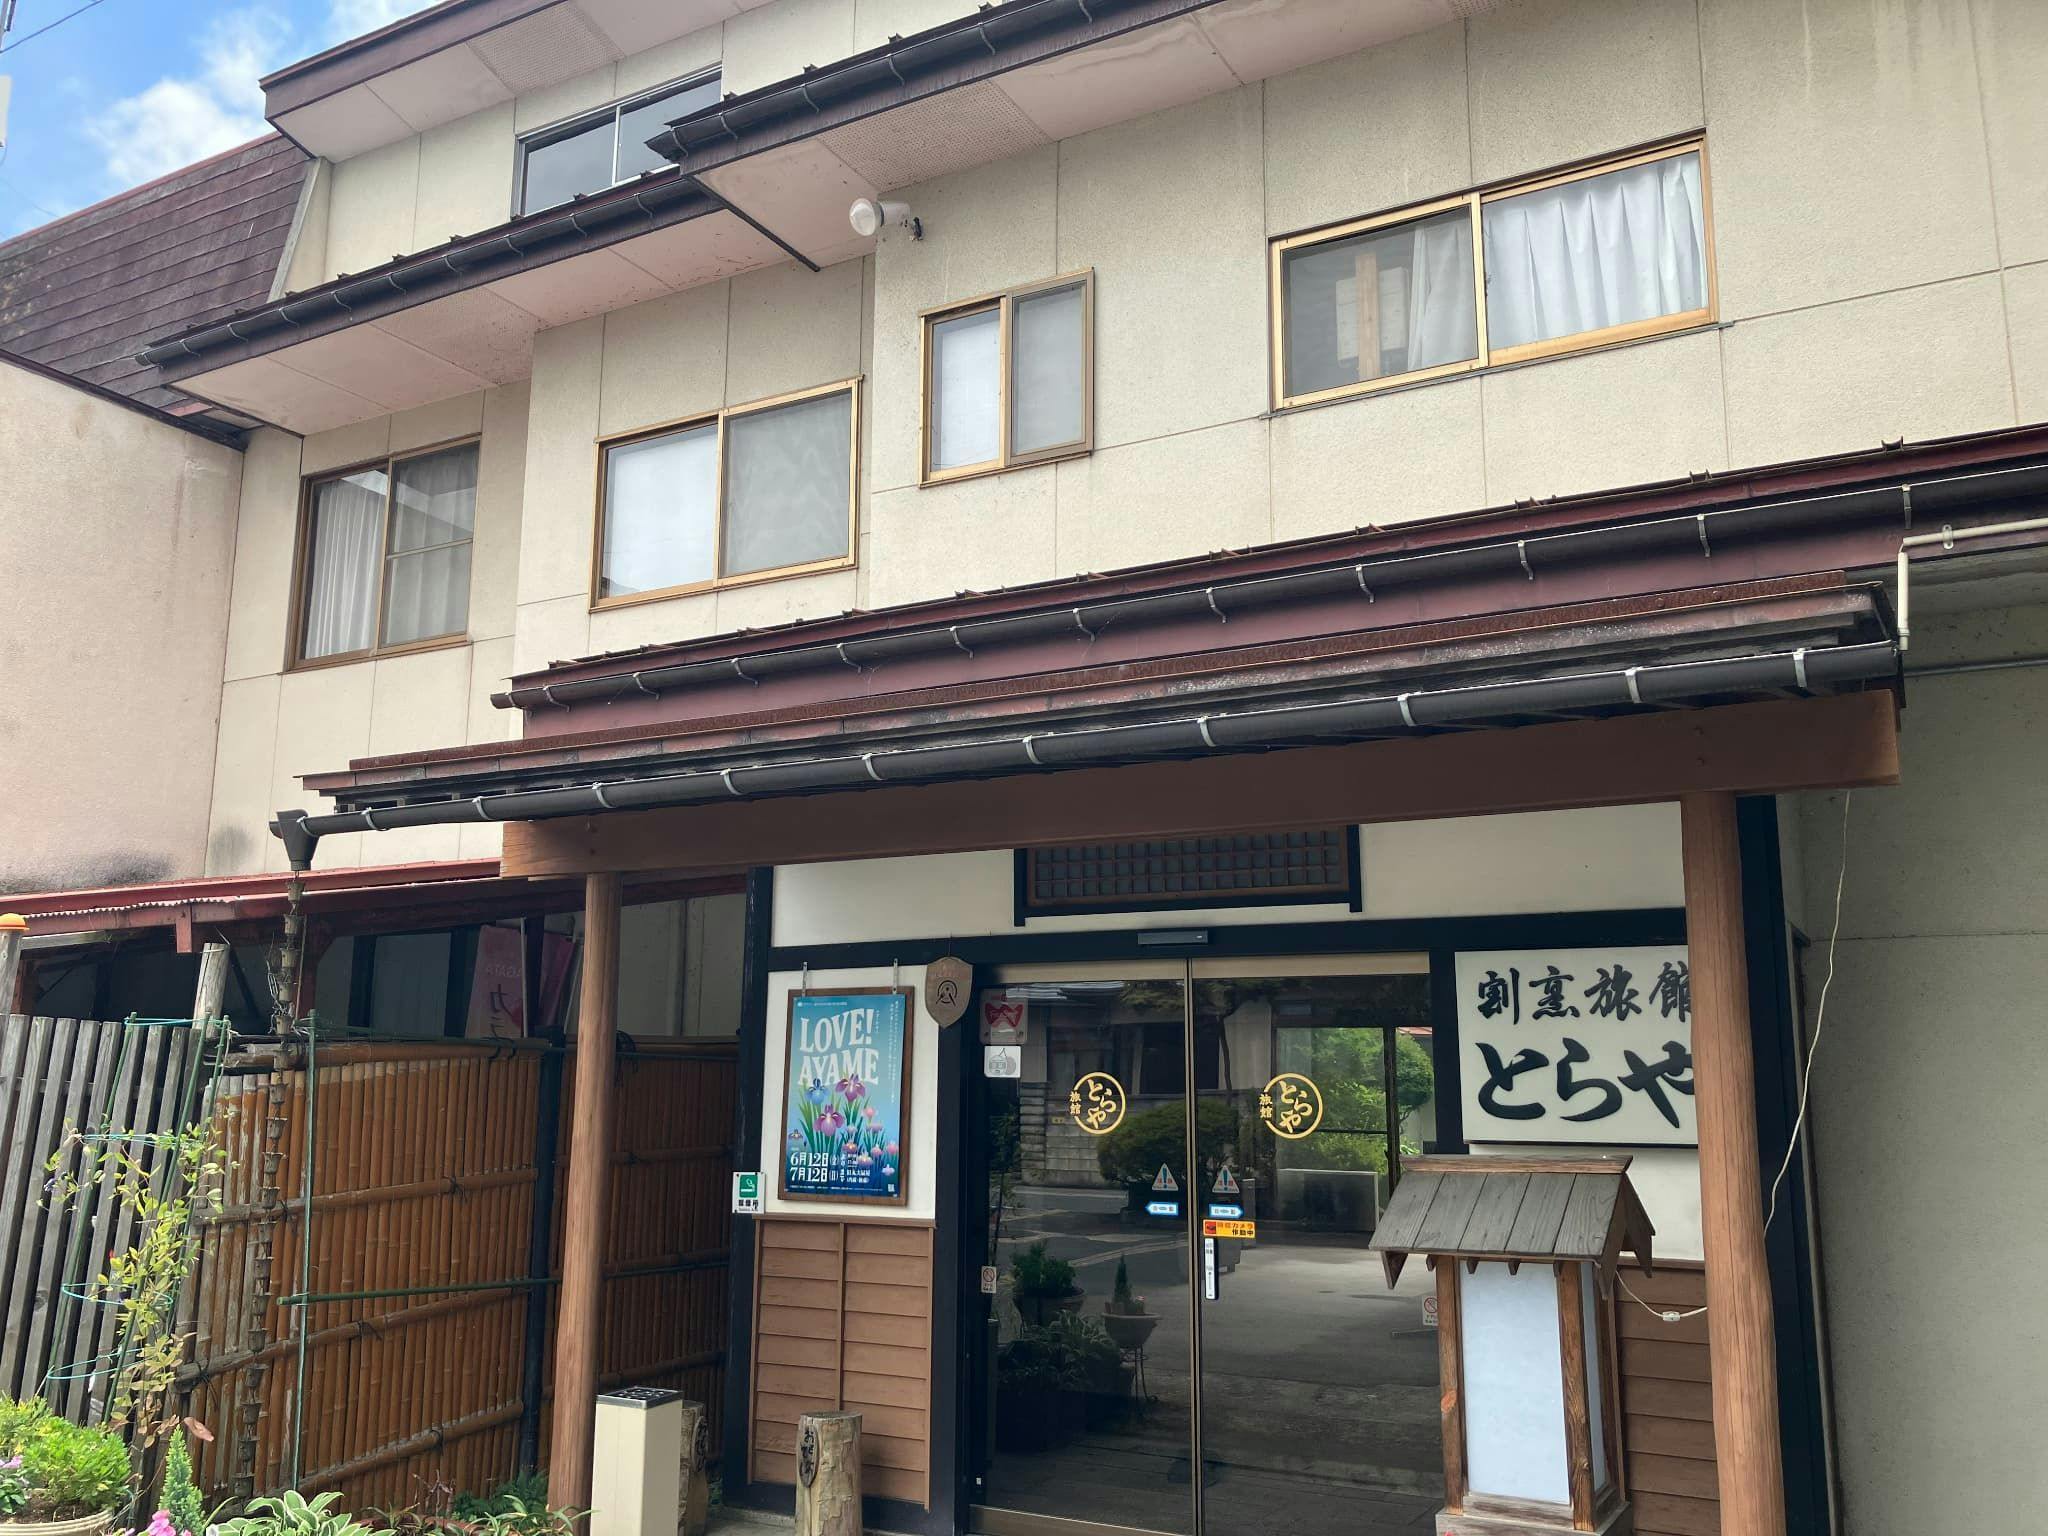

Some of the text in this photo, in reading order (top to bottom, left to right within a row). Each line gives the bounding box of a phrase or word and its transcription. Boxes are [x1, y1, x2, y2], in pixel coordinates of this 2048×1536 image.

[1477, 960, 1692, 1025] 割烹旅館
[799, 1007, 875, 1053] LOVE!
[797, 1046, 880, 1086] AYAME
[1475, 1037, 1695, 1129] とらや
[1087, 1079, 1117, 1129] とらや
[1279, 1080, 1313, 1133] とらや
